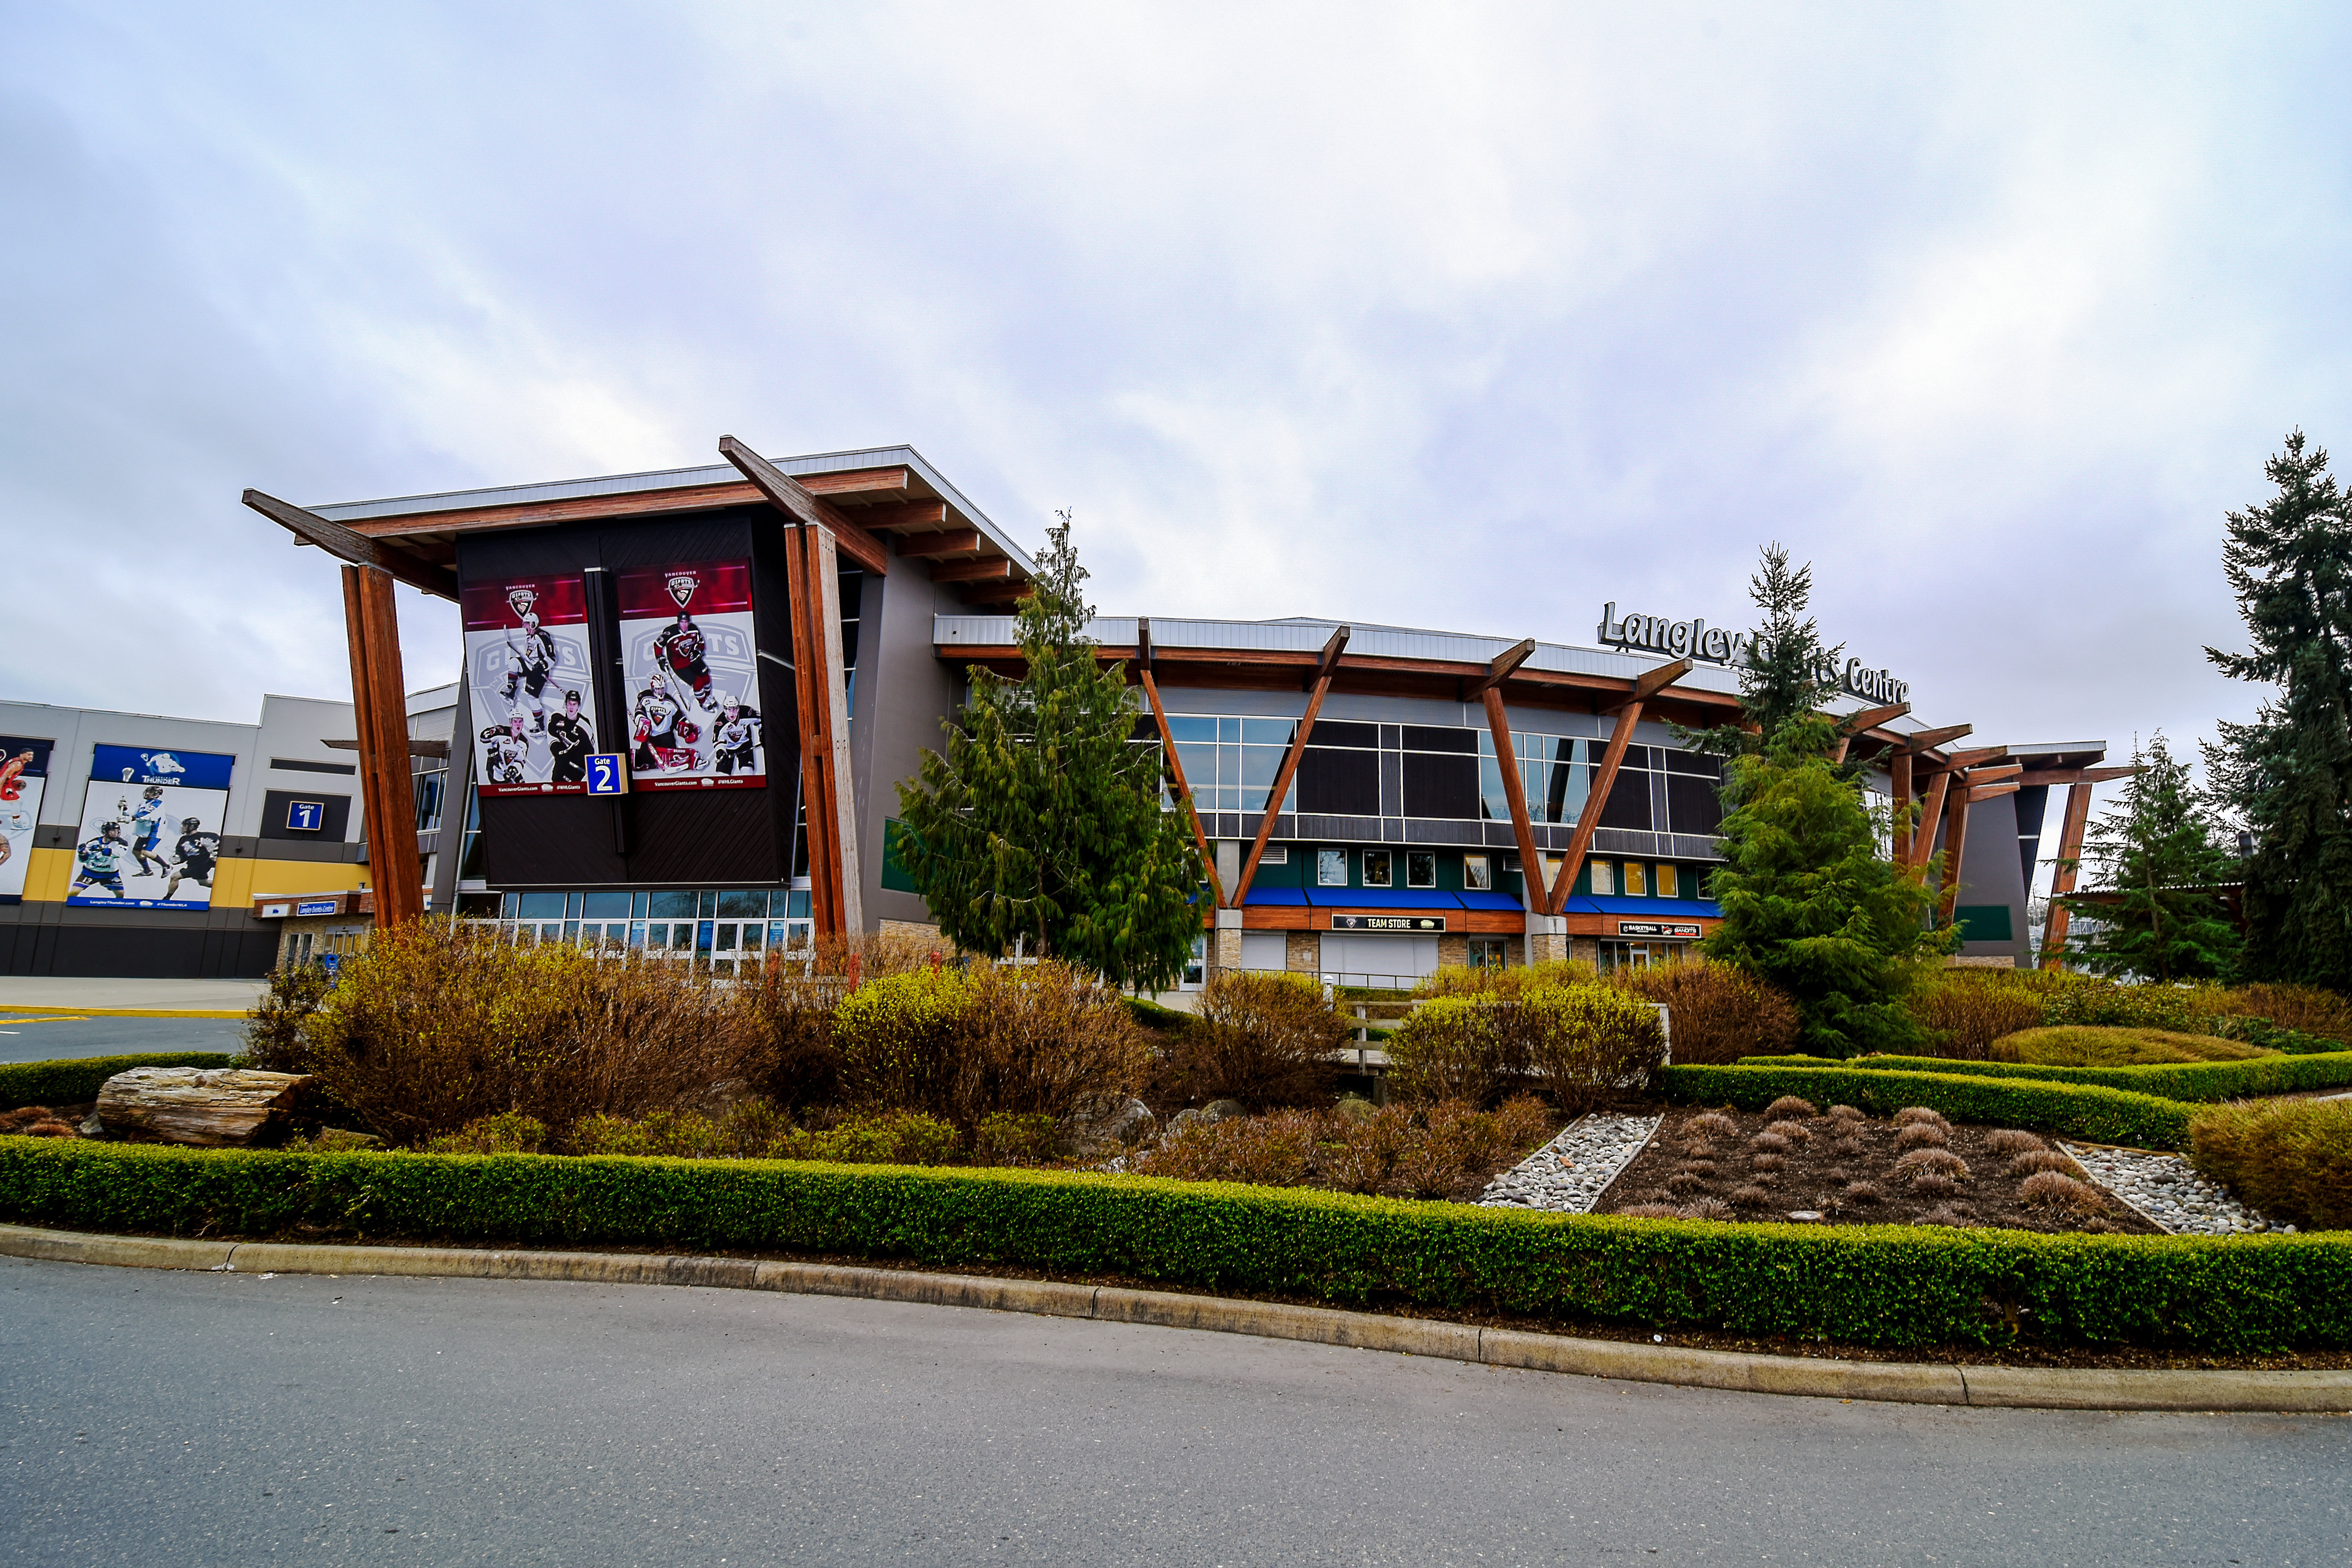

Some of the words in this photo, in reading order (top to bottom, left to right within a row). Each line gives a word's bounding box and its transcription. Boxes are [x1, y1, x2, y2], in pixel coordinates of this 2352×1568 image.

[1603, 601, 1744, 666] Langley
[1846, 657, 1908, 705] Centre
[141, 775, 181, 786] THUNDER
[595, 765, 613, 791] 2
[299, 810, 310, 827] 1
[1368, 919, 1387, 928] TEAM
[1388, 920, 1411, 929] STORE
